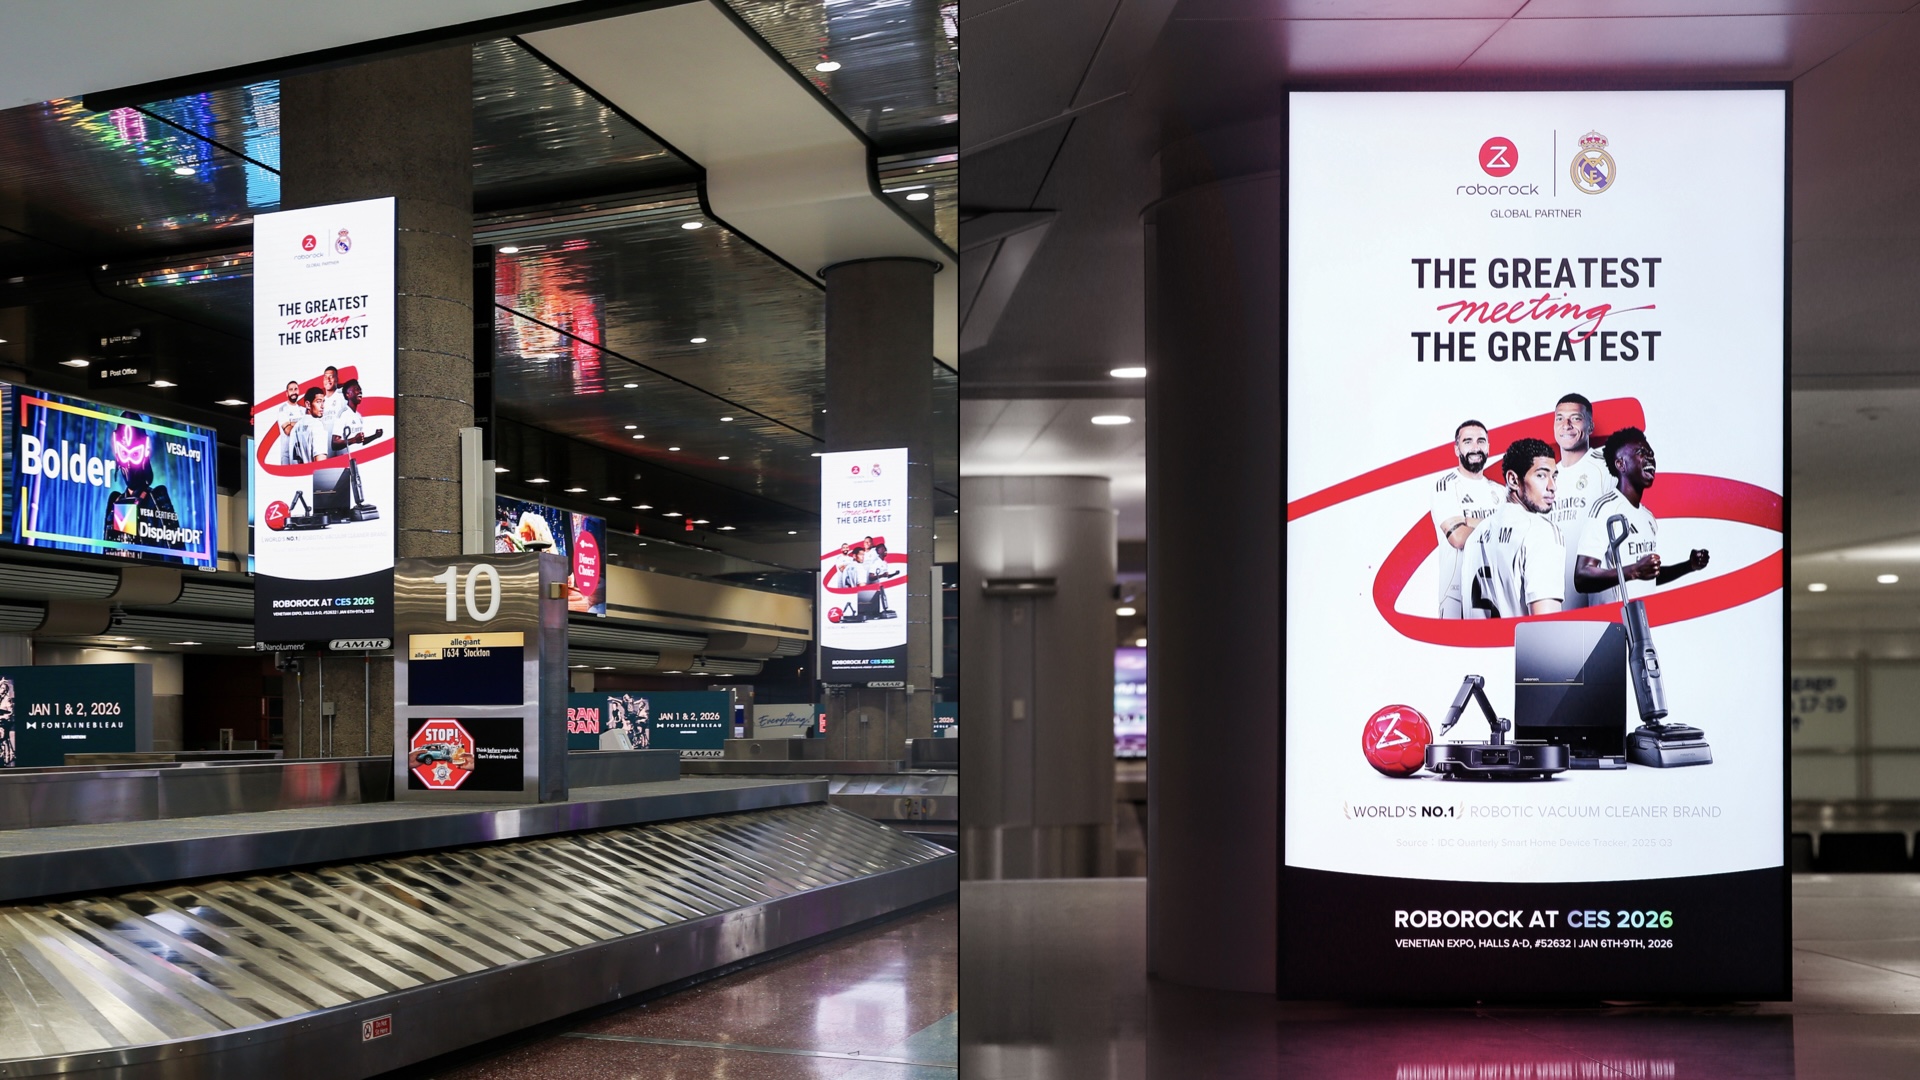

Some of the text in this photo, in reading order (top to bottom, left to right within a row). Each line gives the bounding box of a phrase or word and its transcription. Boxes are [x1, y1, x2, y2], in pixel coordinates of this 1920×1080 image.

[1456, 183, 1539, 196] roborock
[1490, 209, 1582, 218] GLOBAL PARTNER
[1411, 257, 1662, 289] THE GREATEST
[278, 295, 368, 317] THE GREATEST
[287, 313, 366, 333] meeting
[1436, 292, 1656, 344] meeting
[278, 325, 368, 346] THE GREATEST
[1411, 331, 1662, 362] THE GREATEST
[166, 442, 201, 462] VESA.org
[21, 434, 116, 488] Bolder
[853, 499, 892, 508] GREATEST
[140, 508, 179, 520] VESA CERTIFIED
[836, 514, 892, 525] THE GREATEST
[578, 565, 595, 577] Choice
[434, 563, 501, 622] 10
[273, 597, 375, 608] ROBOROCK AT CES 2026
[264, 643, 304, 652] NanoLumens
[335, 640, 383, 649] LAMAR
[450, 638, 481, 648] allegiant
[443, 647, 491, 658] 1634 Stockton
[28, 702, 121, 717] JAN 1 & 2, 2026
[658, 712, 721, 722] JAN 1 & 2, 2026
[758, 711, 815, 728] Everything!
[41, 721, 124, 729] FONTAINEBLEAU
[425, 728, 459, 742] STOP!
[1353, 805, 1722, 818] WORLD'S NO.1 ROBOTIC VACUUM CLEANER BRAND
[1438, 838, 1454, 847] IDC
[1457, 838, 1498, 849] Quarterly
[1501, 838, 1527, 847] Smart
[1530, 838, 1557, 847] Home
[1559, 838, 1591, 847] Device
[1593, 838, 1629, 849] Tracker,
[1632, 838, 1657, 847] 2025
[1659, 838, 1673, 847] Q3
[1394, 910, 1674, 928] ROBOROCK AT CES 2026
[1395, 939, 1445, 948] VENETIAN
[1447, 939, 1476, 949] EXPO,
[1478, 939, 1510, 948] HALLS
[1512, 939, 1532, 949] A-D,
[1534, 939, 1572, 948] #52632
[1578, 939, 1598, 948] JAN
[1600, 939, 1646, 949] 6TH-9TH,
[1648, 939, 1673, 948] 2026
